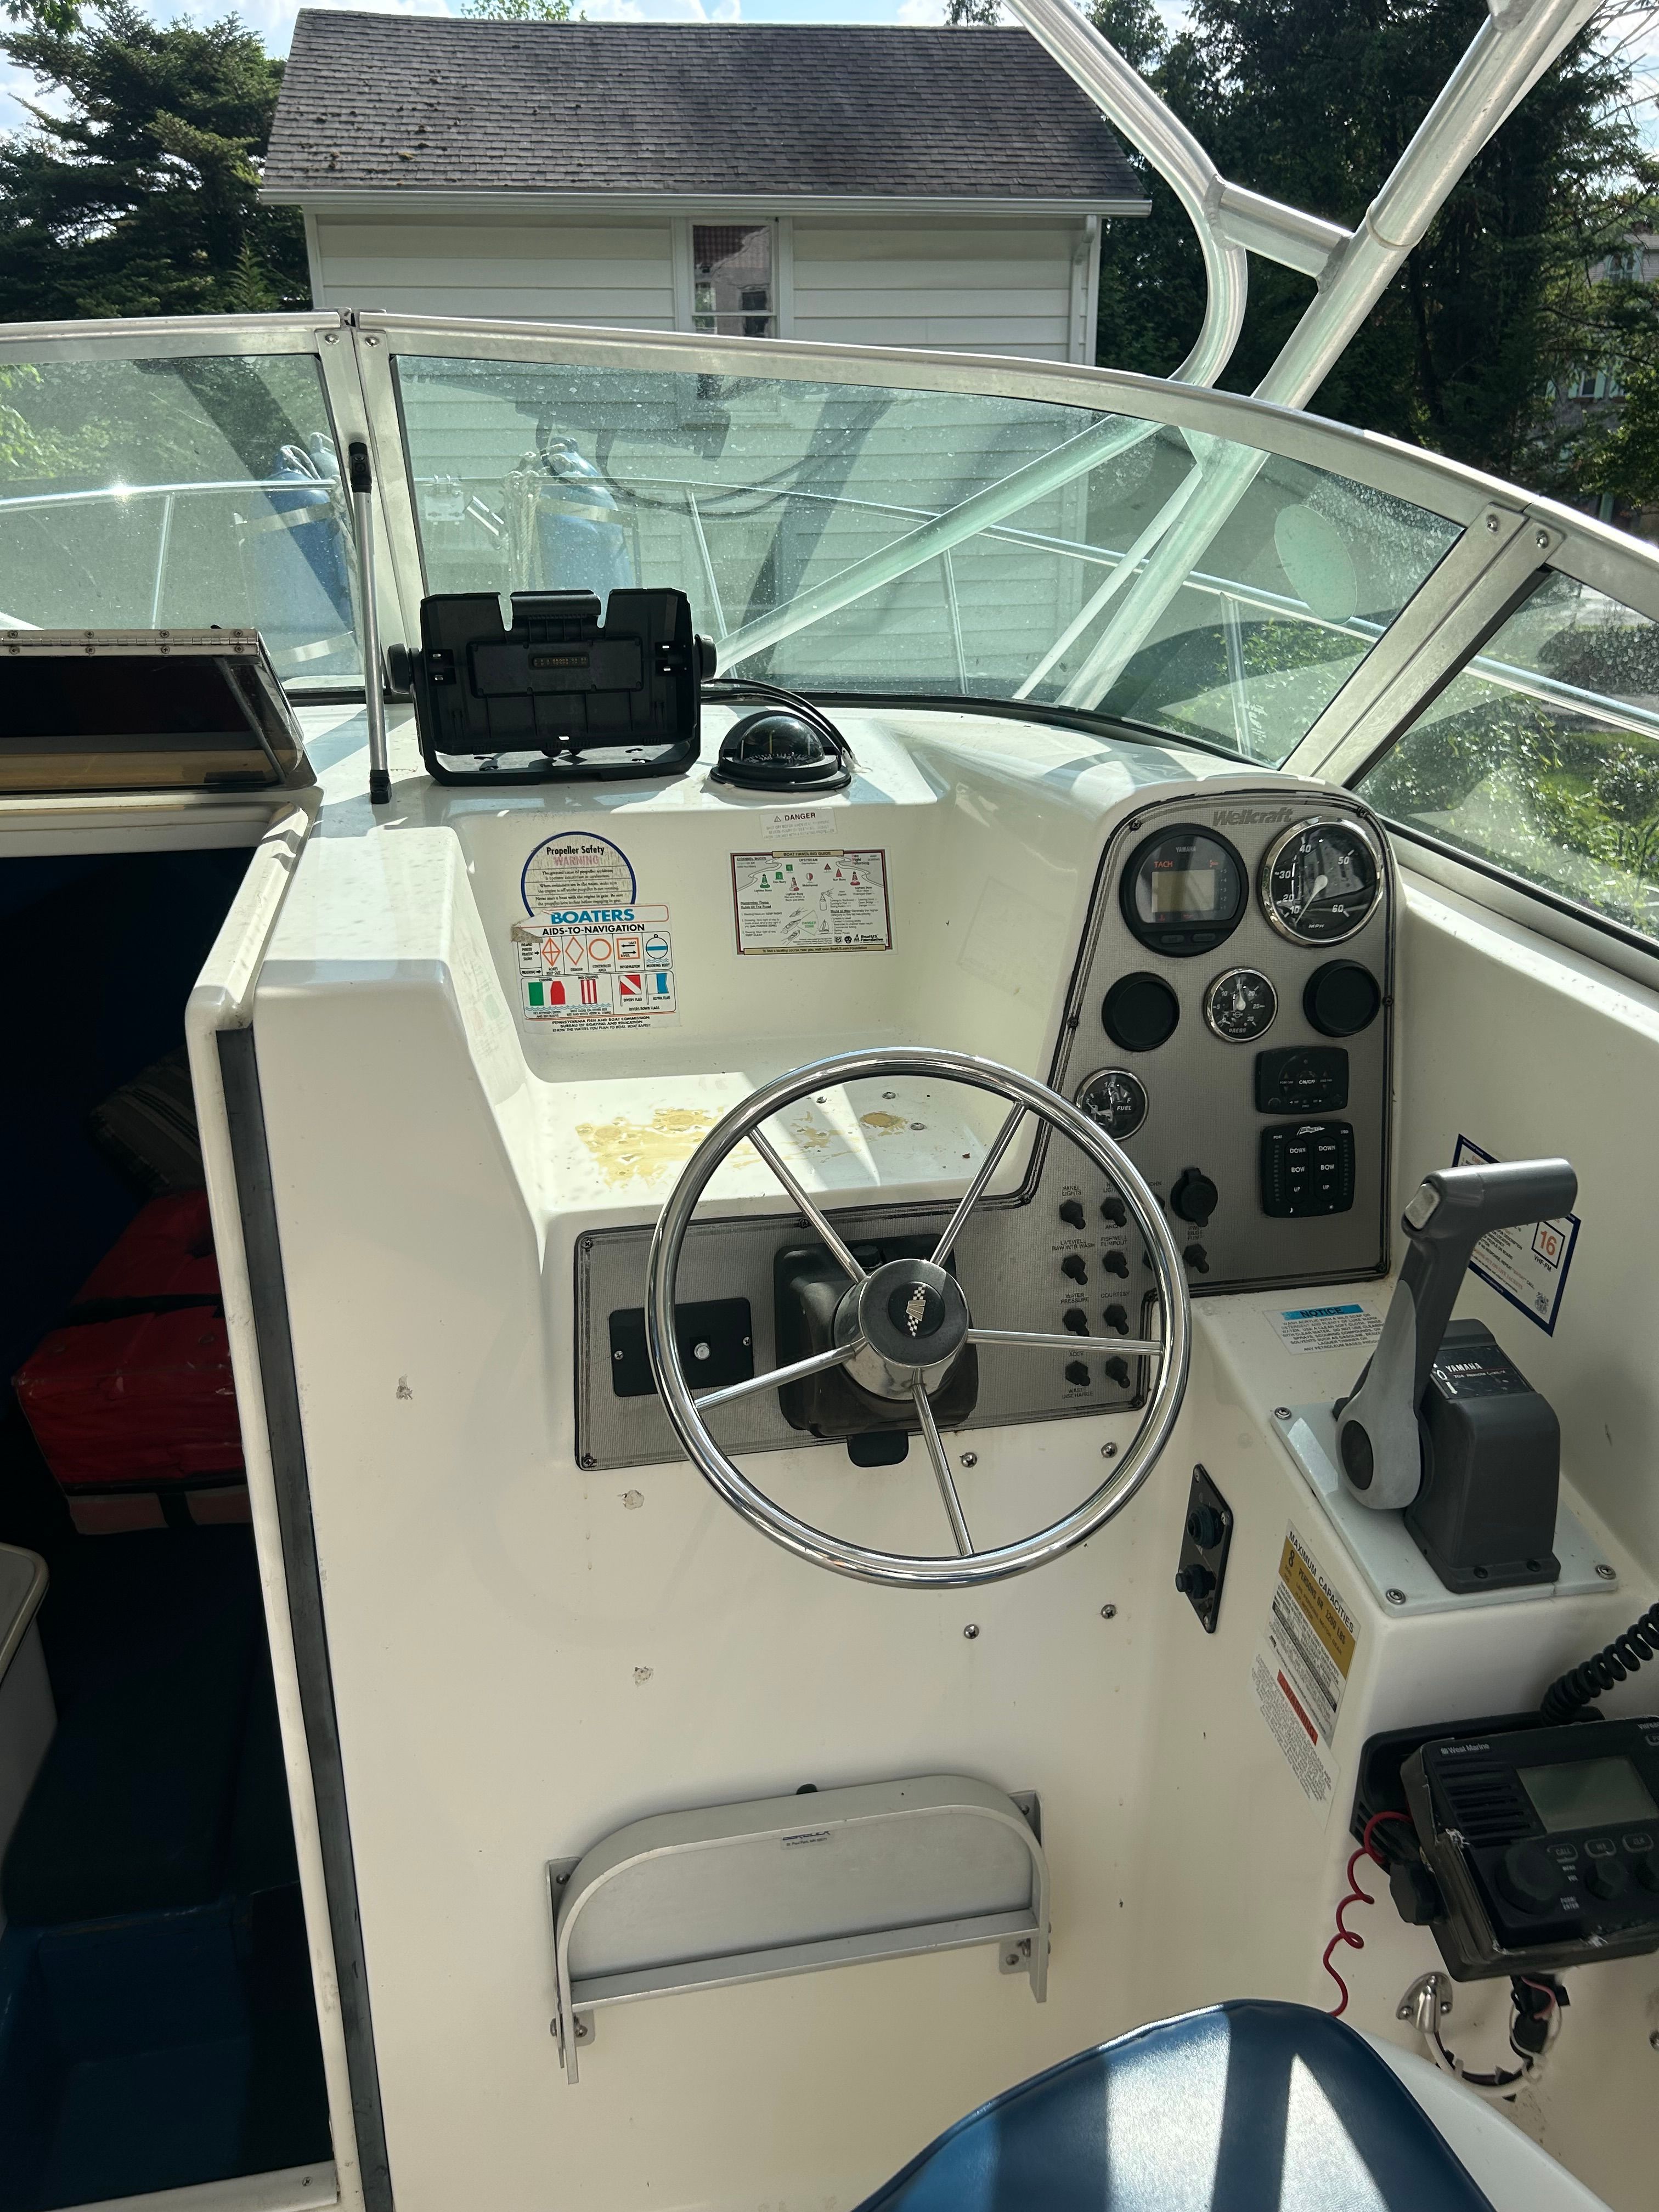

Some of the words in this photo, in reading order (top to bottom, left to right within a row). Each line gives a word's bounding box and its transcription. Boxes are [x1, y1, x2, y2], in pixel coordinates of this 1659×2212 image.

[785, 812, 816, 821] DANGER
[1212, 806, 1294, 826] Wellcraft
[546, 845, 579, 856] Propeller
[581, 845, 605, 855] Safety
[1299, 844, 1311, 853] 40
[553, 855, 599, 866] WARNING
[1338, 856, 1350, 865] 50
[1279, 870, 1291, 879] 30
[1282, 894, 1294, 902] 20
[1290, 906, 1300, 914] 10
[1332, 905, 1344, 913] 60
[551, 909, 635, 925] BOATERS
[542, 924, 645, 936] AIDS-TO-NAVIGATION
[1540, 1230, 1557, 1256] 16
[1534, 1254, 1552, 1273] VHF-FM
[1299, 1306, 1345, 1317] NOTICE
[1445, 1362, 1482, 1372] YAMAHA
[1288, 1547, 1296, 1569] 8
[1288, 1530, 1317, 1577] MAXIMUM
[1318, 1574, 1355, 1634] CAPACITIES
[1298, 1566, 1317, 1600] PERSONS
[1316, 1594, 1324, 1611] OR
[1325, 1607, 1337, 1631] 1200
[1336, 1626, 1346, 1645] LBS
[1448, 1745, 1466, 1754] West
[1467, 1742, 1489, 1752] Marine
[1556, 1847, 1571, 1856] CALL
